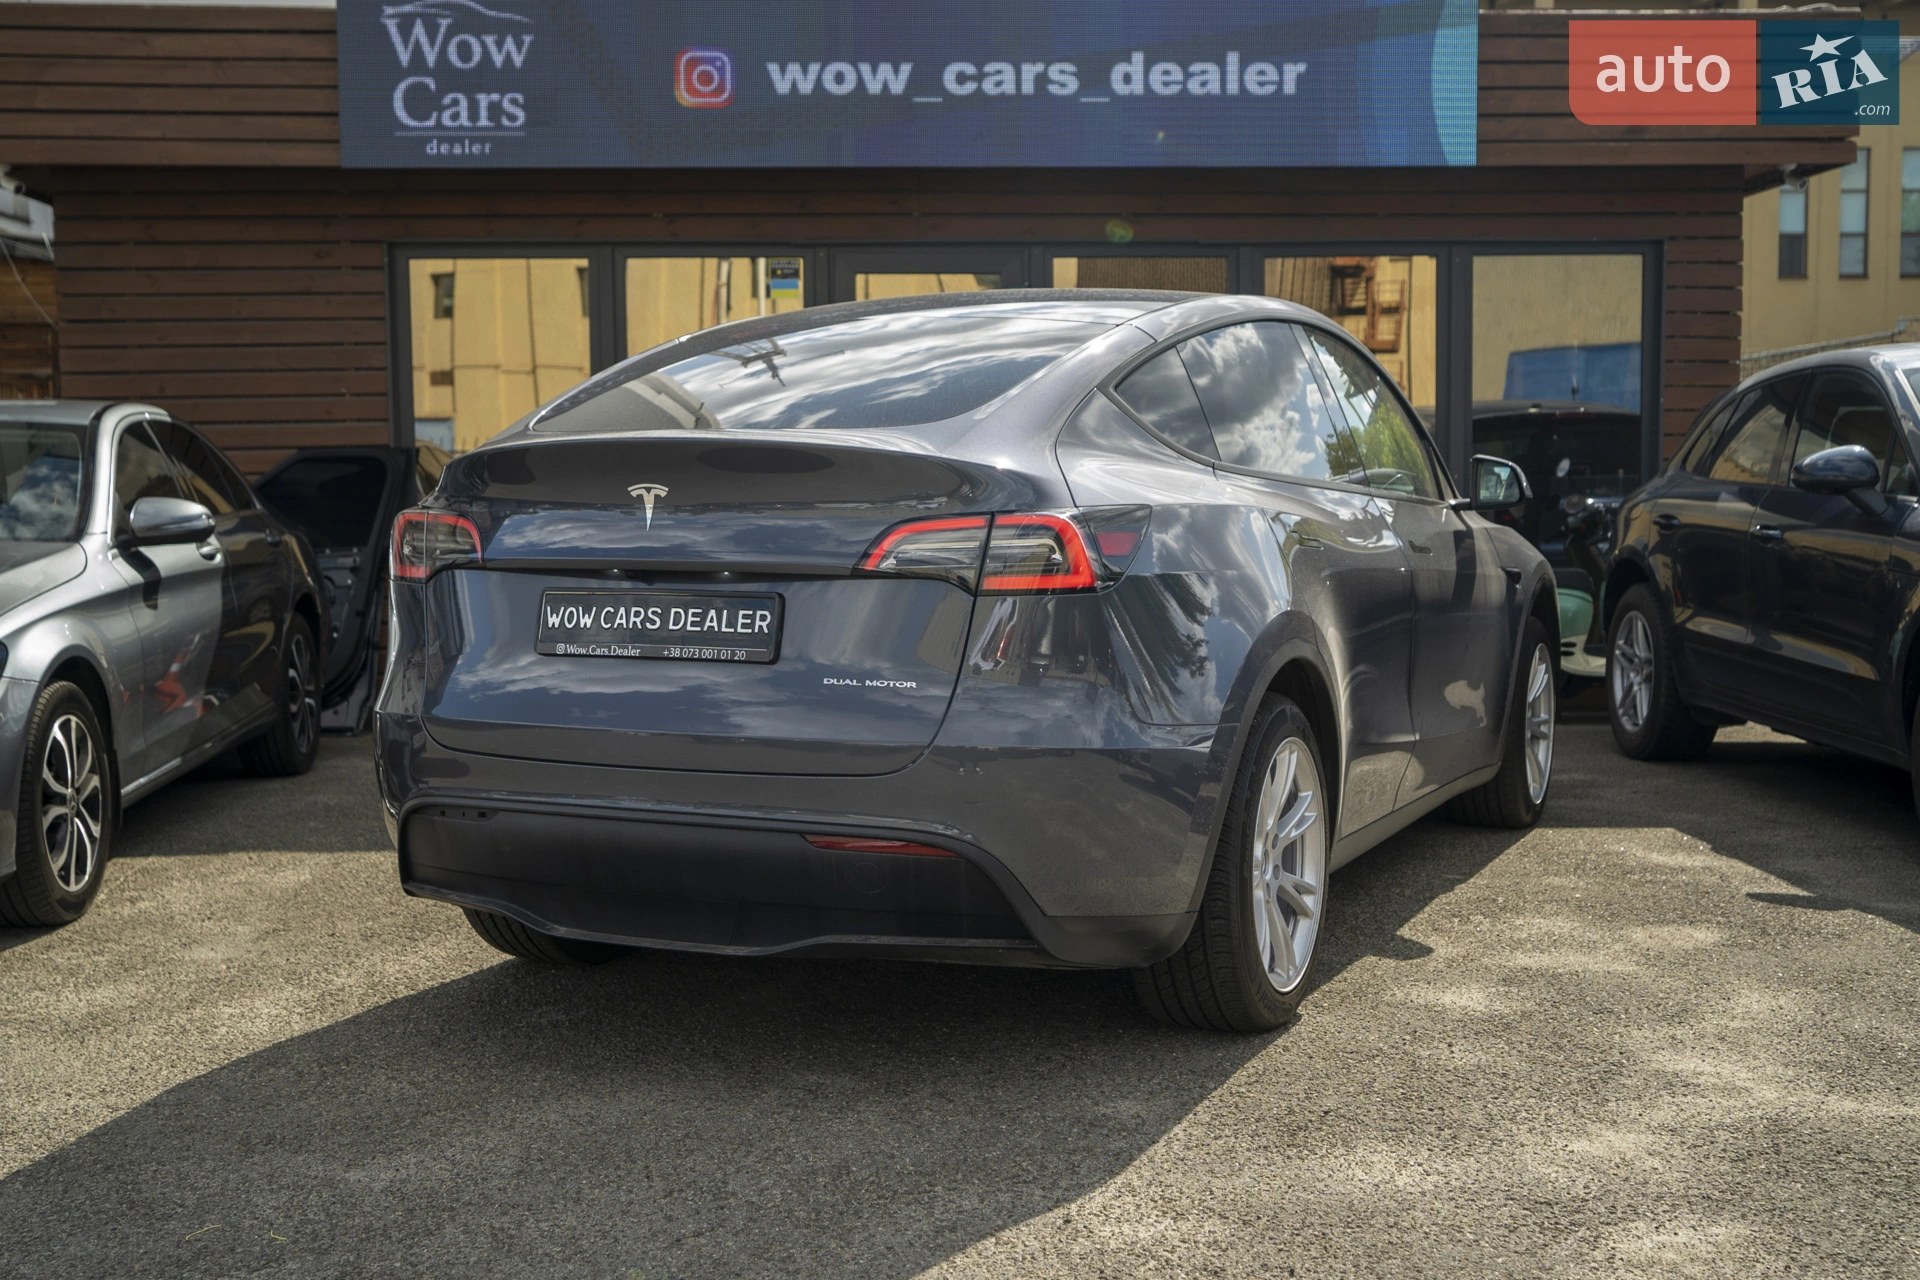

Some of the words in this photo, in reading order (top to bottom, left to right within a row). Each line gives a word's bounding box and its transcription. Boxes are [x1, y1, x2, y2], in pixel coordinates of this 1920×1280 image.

[384, 17, 534, 69] Wow
[767, 51, 1307, 102] wow_cars_dealer
[393, 76, 526, 128] Cars
[426, 138, 492, 155] dealer
[546, 606, 597, 630] WOW
[600, 606, 662, 631] CARS
[668, 607, 772, 634] DEALER
[663, 647, 681, 658] +38
[682, 648, 700, 659] 073
[701, 649, 718, 660] 001
[720, 650, 732, 660] 01
[734, 650, 746, 661] 20
[823, 678, 862, 686] DUAL
[865, 679, 917, 689] MOTOR
